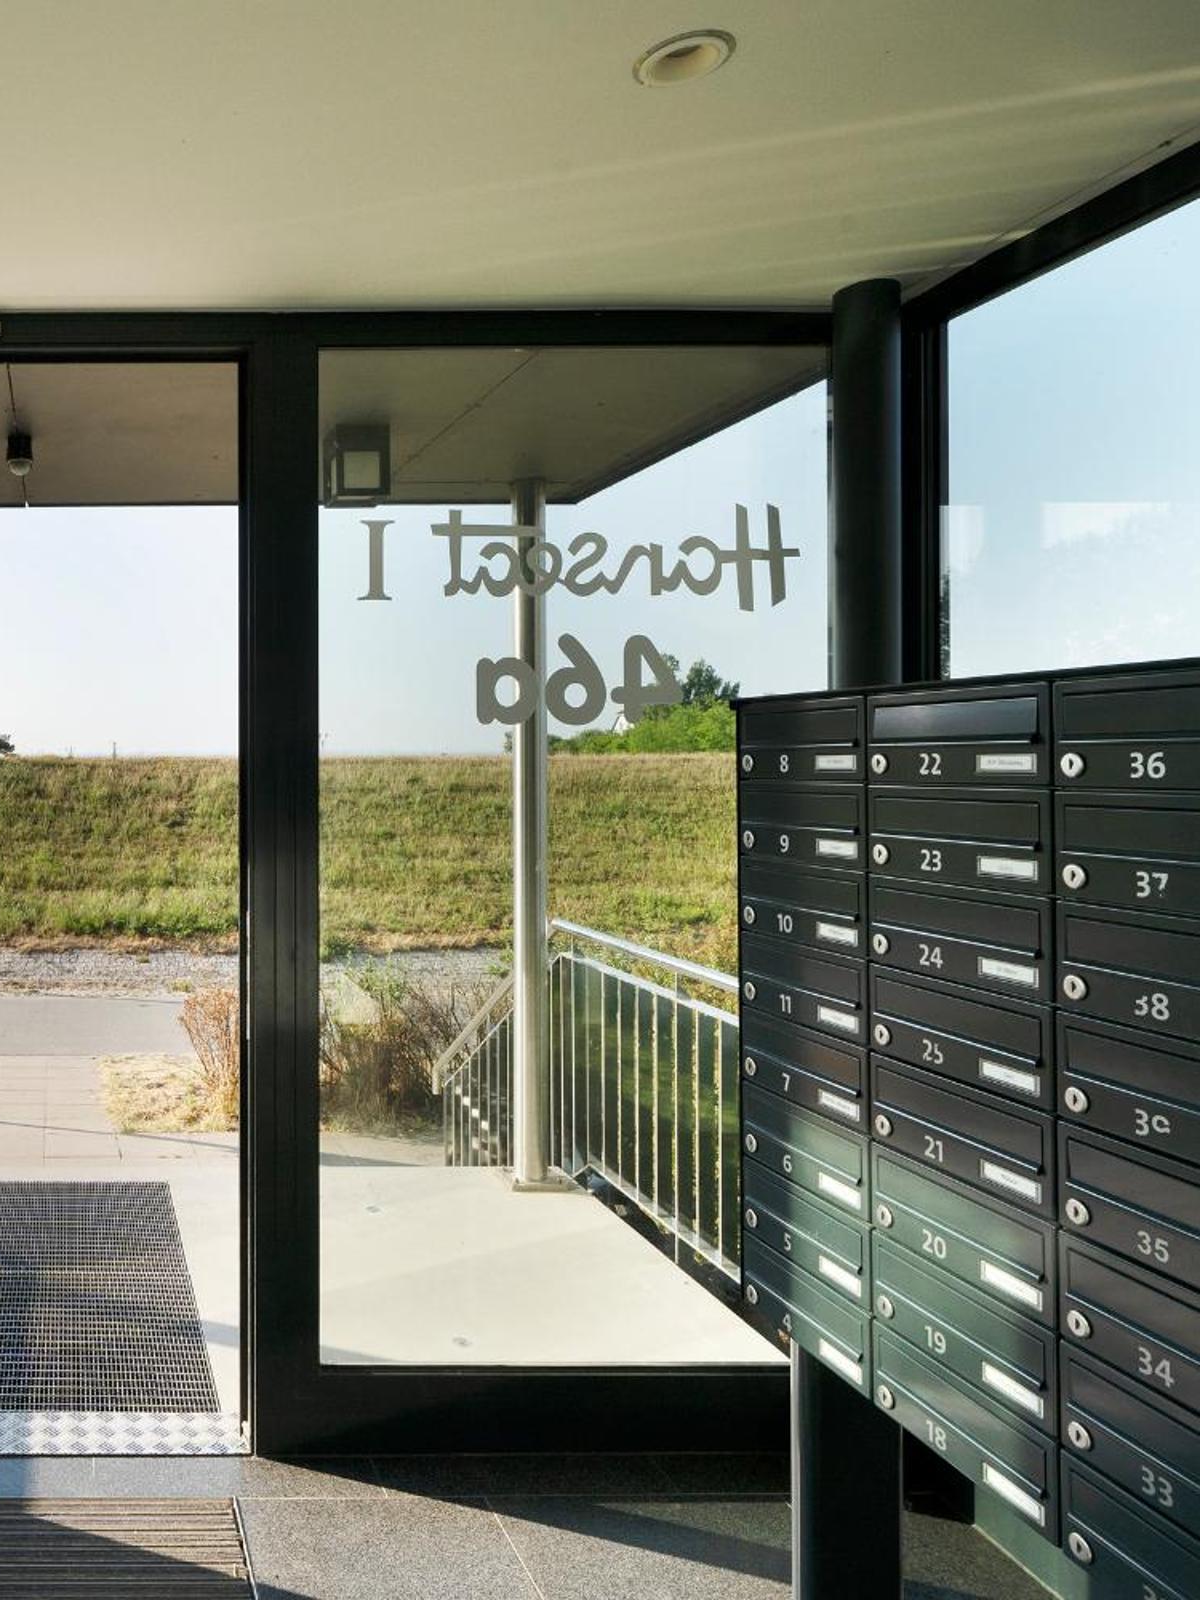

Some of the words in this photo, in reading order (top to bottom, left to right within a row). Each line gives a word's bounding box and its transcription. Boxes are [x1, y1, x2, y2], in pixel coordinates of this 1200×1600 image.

[779, 754, 789, 773] 8
[919, 753, 942, 775] 22
[1129, 751, 1166, 779] 36
[779, 834, 789, 853] 9
[920, 849, 942, 872] 23
[1136, 871, 1169, 898] 37
[777, 913, 793, 933] 10
[919, 943, 944, 969] 24
[779, 994, 792, 1014] 11
[922, 1038, 943, 1064] 25
[782, 1072, 791, 1092] 7
[923, 1136, 944, 1163] 21
[783, 1155, 792, 1173] 6
[784, 1232, 792, 1252] 5
[922, 1230, 947, 1259] 20
[1137, 1230, 1169, 1264] 35
[782, 1313, 792, 1332] 4
[923, 1326, 947, 1354] 19
[1137, 1347, 1175, 1388] 34
[925, 1420, 947, 1450] 18
[1141, 1465, 1174, 1508] 33
